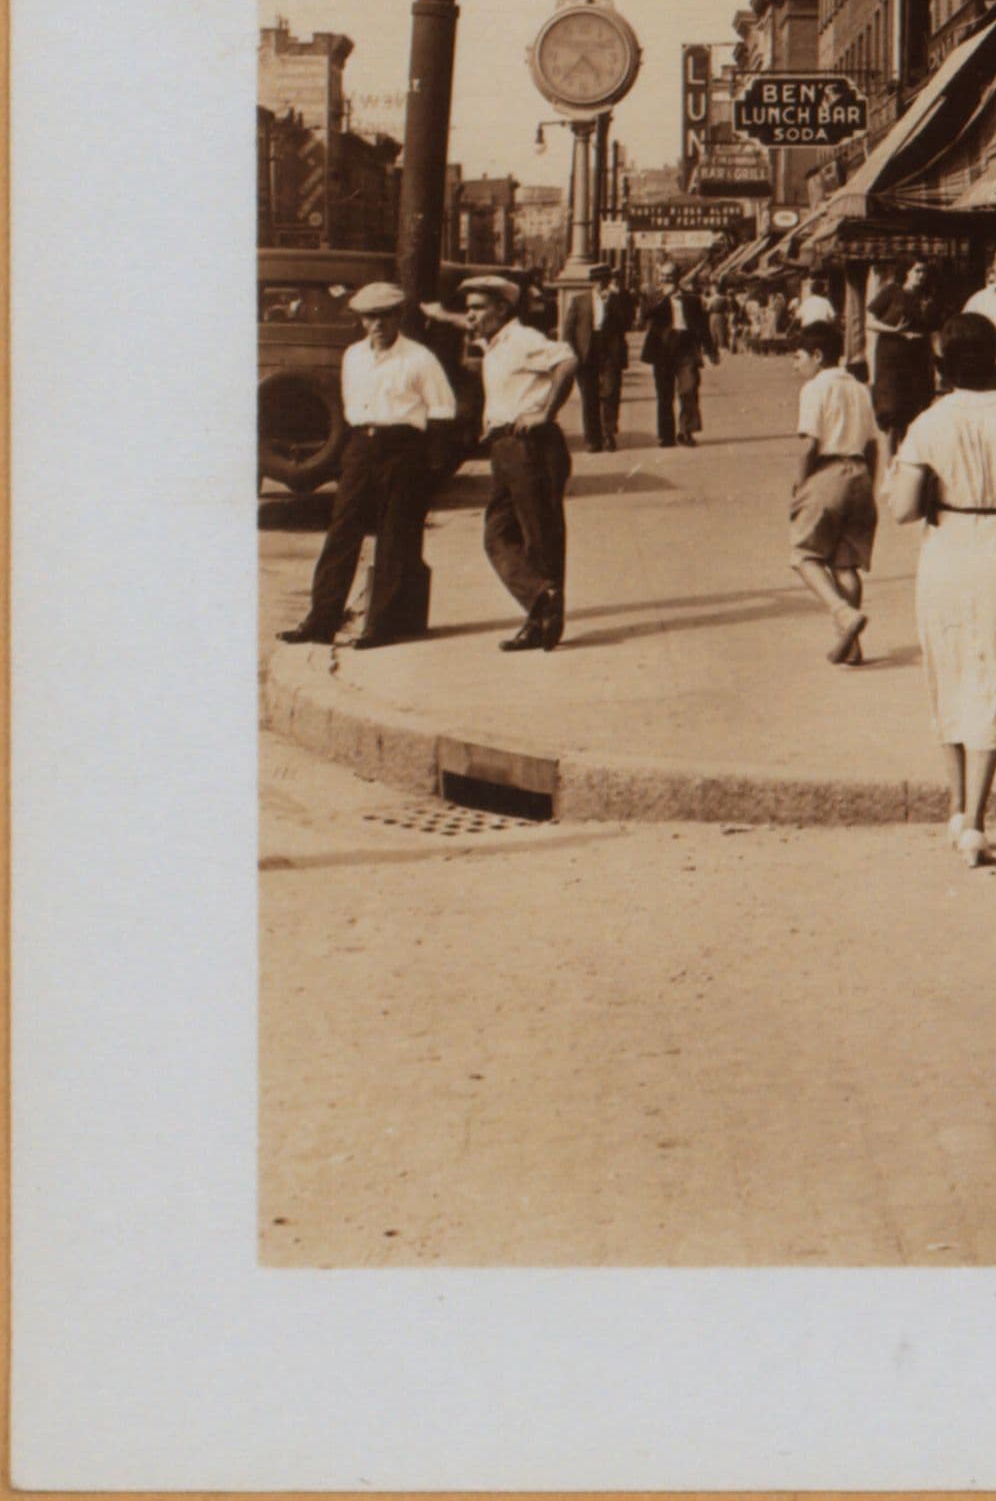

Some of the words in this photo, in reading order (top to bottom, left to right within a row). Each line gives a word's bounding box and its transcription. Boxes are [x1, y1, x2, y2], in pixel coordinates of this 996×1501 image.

[762, 83, 838, 104] BEN'S
[741, 106, 811, 125] LUNCH
[817, 106, 860, 124] BAR
[773, 127, 828, 141] SODA
